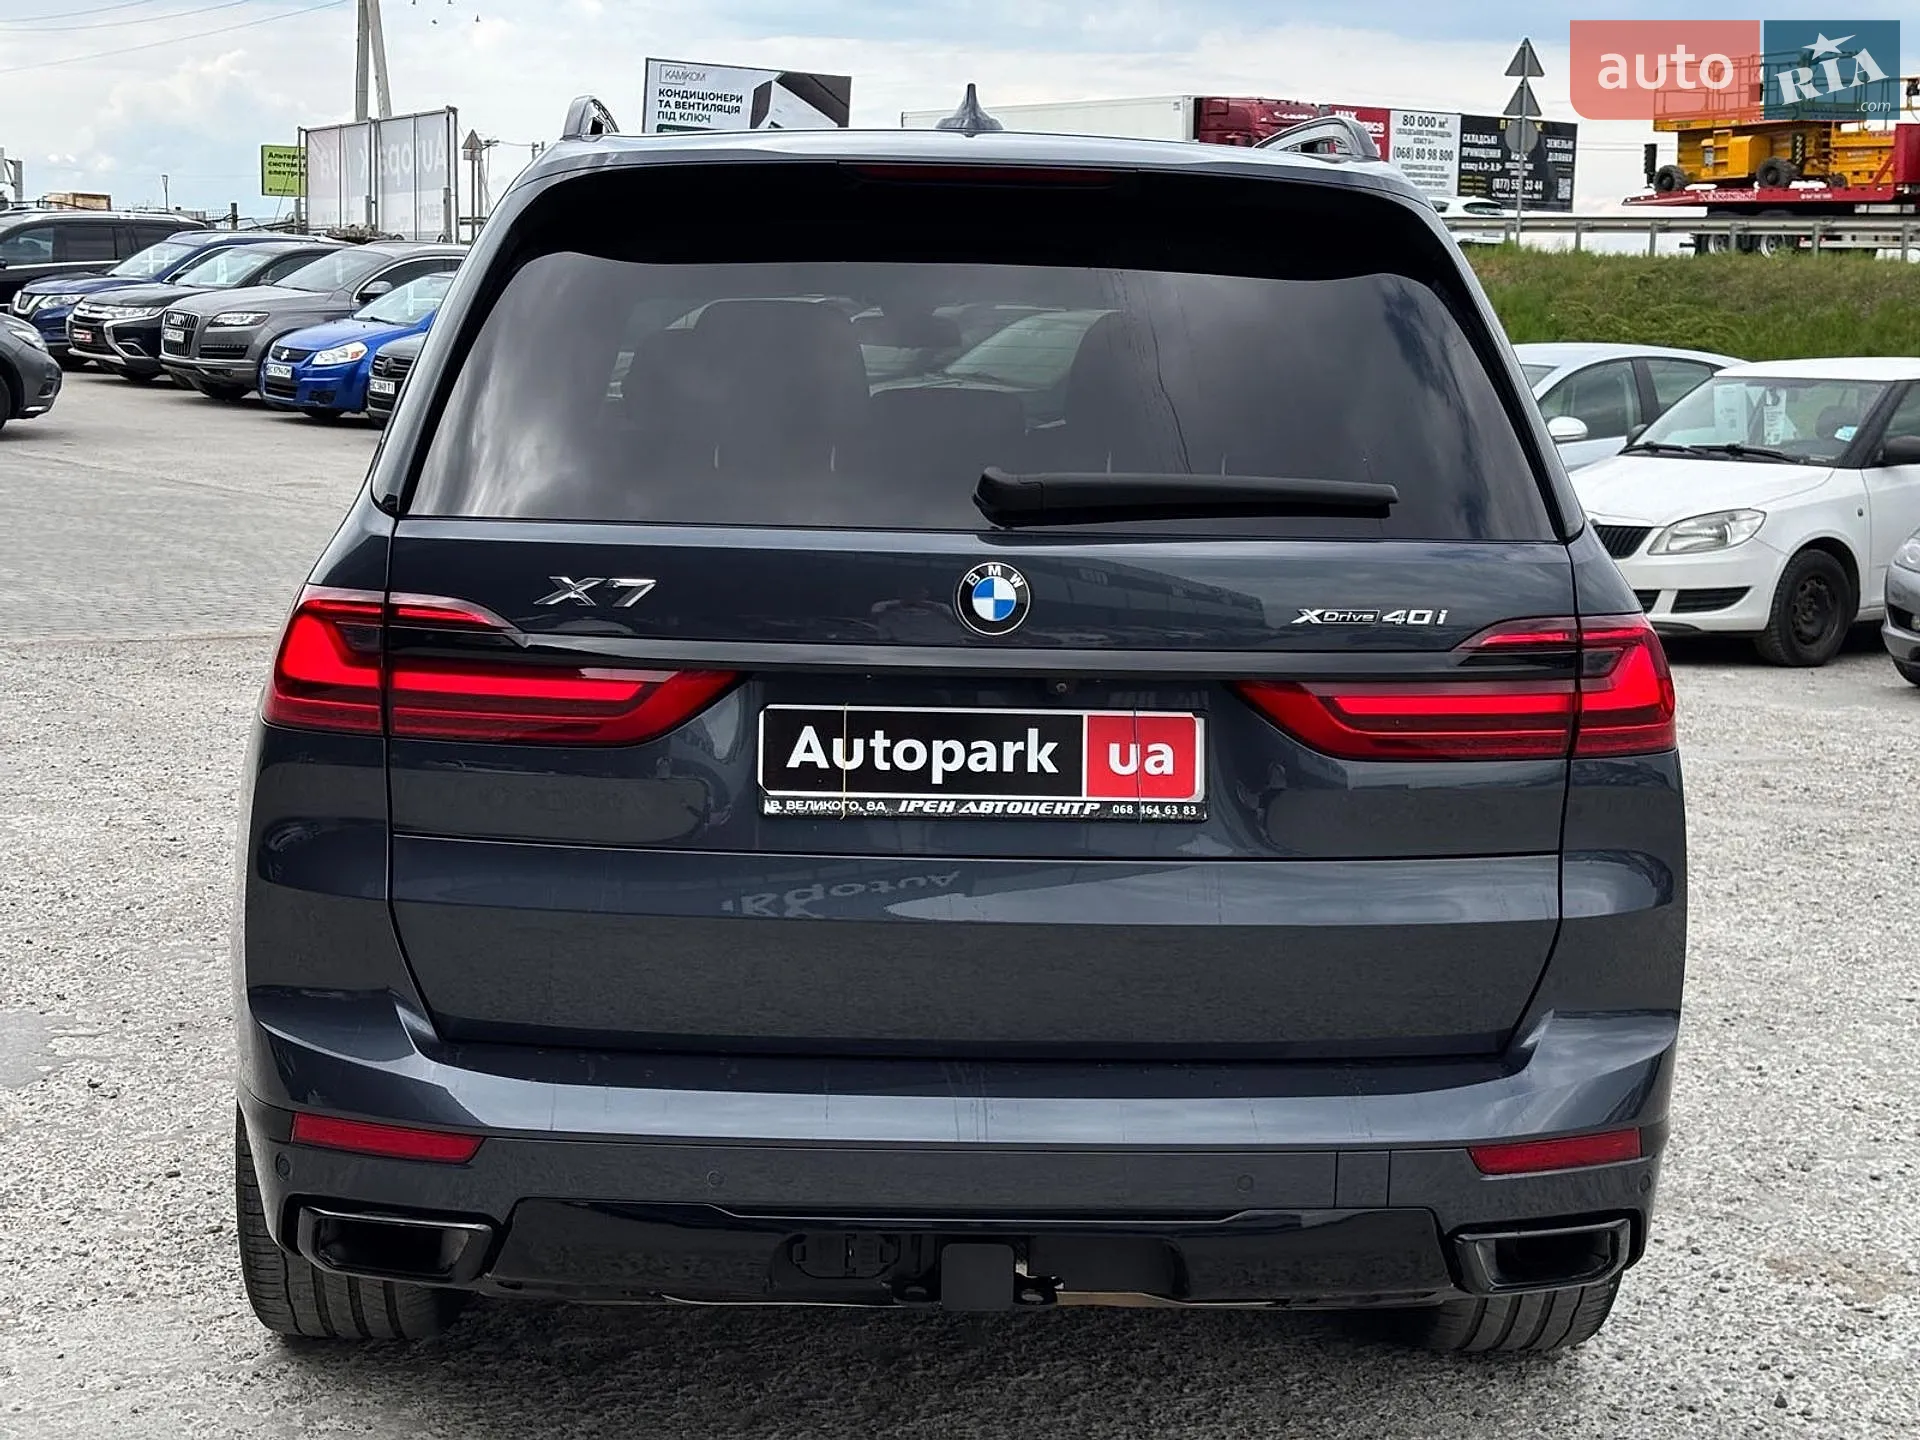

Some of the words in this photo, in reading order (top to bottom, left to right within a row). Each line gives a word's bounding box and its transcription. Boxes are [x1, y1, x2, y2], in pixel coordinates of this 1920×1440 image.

[658, 88, 743, 104] КОНДИЦІОНЕРИ
[657, 99, 671, 109] ТА
[674, 100, 741, 115] ВЕНТИЛЯЦІЯ
[657, 111, 676, 122] ПІД
[679, 112, 711, 123] КЛЮЧ
[1402, 115, 1415, 126] 80
[1417, 116, 1437, 128] 000
[966, 565, 1024, 589] BMW
[533, 576, 657, 607] X7
[786, 725, 1060, 784] Autopark
[1109, 742, 1175, 775] ua
[898, 800, 956, 813] ІРЕН
[959, 801, 1100, 816] АВТОЦЕНТР
[1112, 804, 1129, 815] 068
[1164, 805, 1178, 816] 63
[1183, 805, 1197, 816] 83
